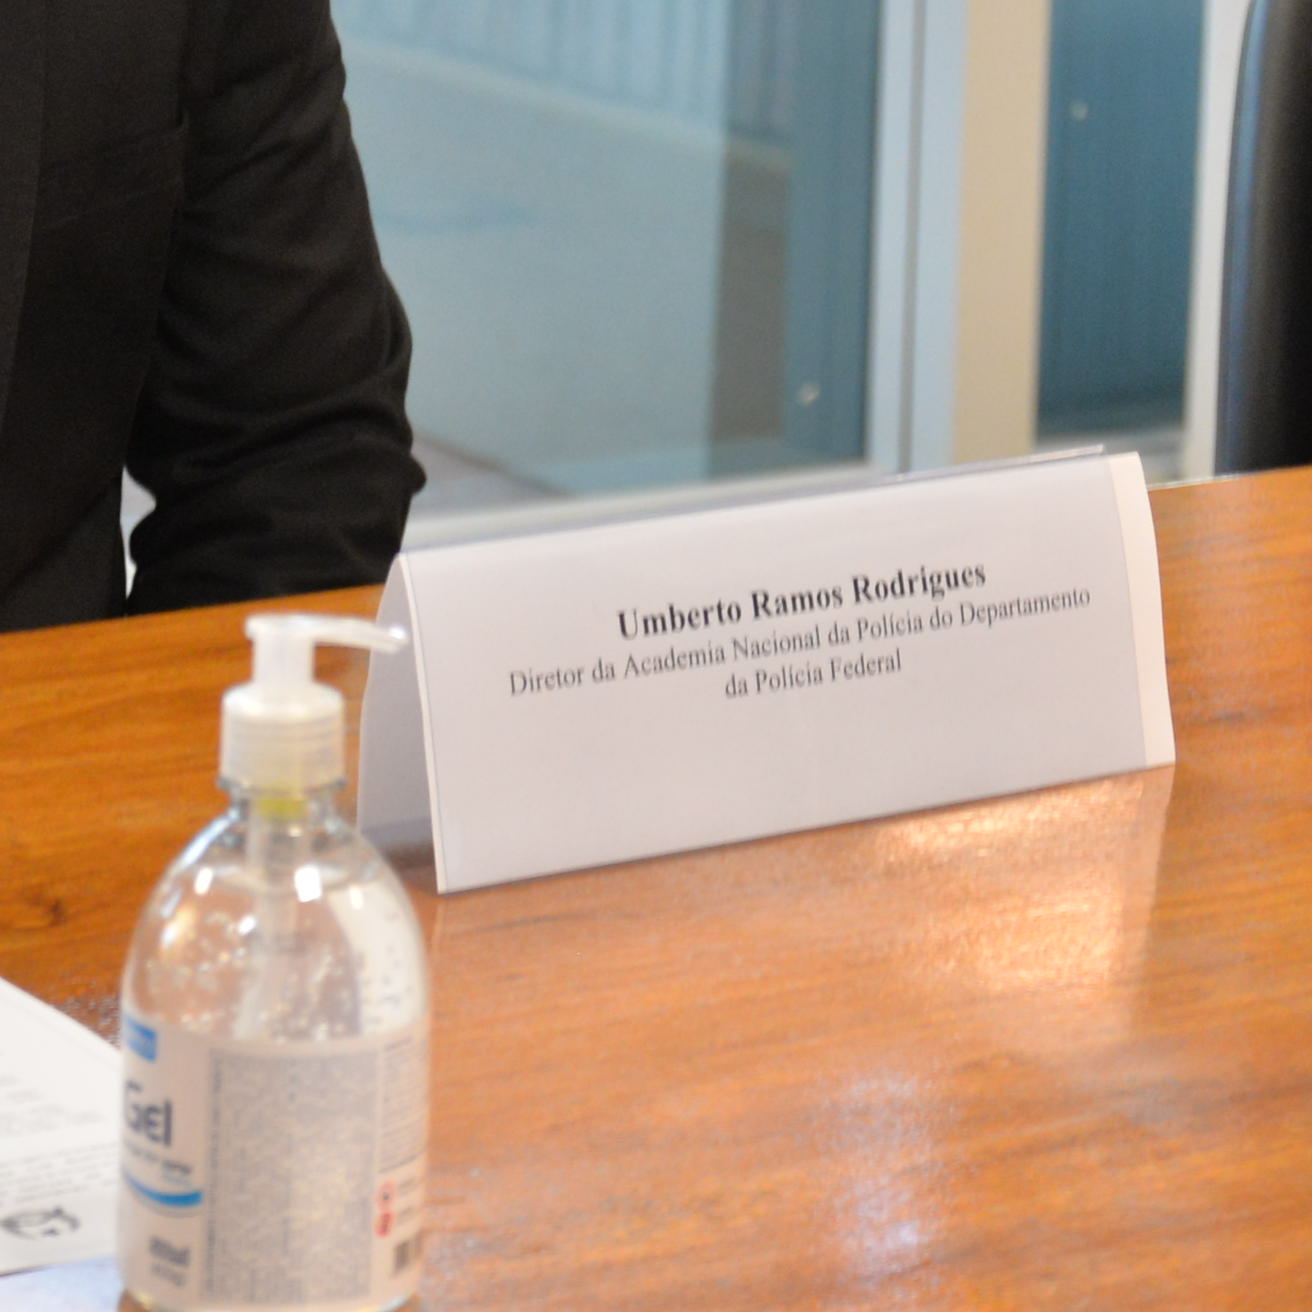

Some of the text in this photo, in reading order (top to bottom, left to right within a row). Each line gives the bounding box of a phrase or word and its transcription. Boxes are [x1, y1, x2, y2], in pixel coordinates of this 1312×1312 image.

[617, 564, 987, 640] Umberto Ramos Rodrigues
[509, 588, 1091, 696] Diretor da Academia Nacional da Polícia do Departamento
[724, 647, 902, 699] da Polícia Federal
